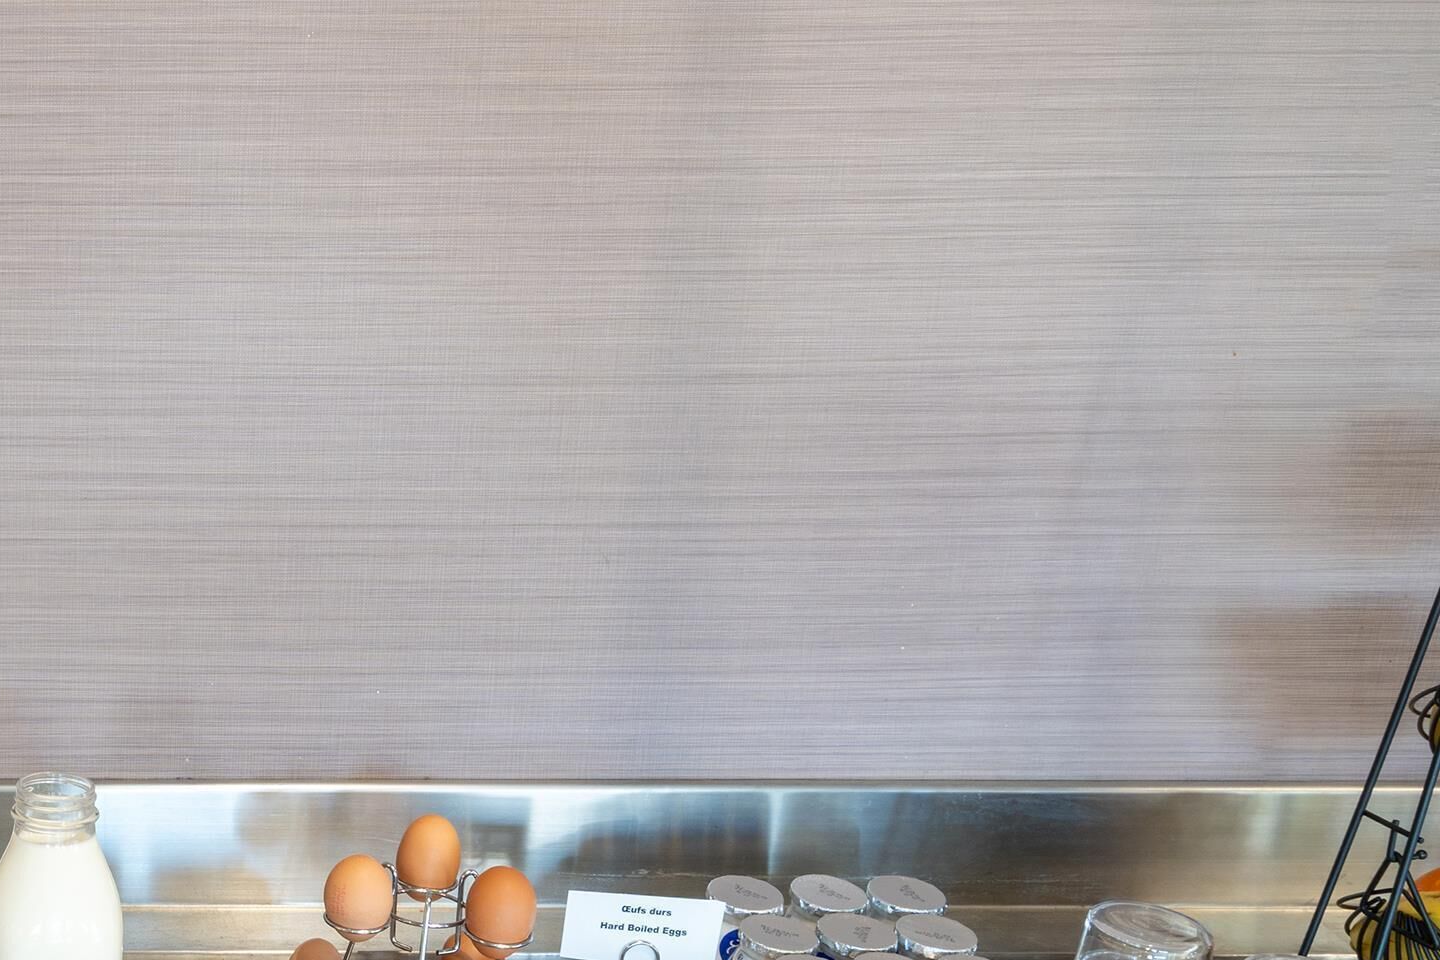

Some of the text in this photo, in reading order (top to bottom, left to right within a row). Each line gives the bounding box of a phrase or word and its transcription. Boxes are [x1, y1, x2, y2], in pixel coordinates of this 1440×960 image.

[621, 905, 672, 917] Œufs durs
[600, 921, 688, 938] Hard Boiled Eggs
